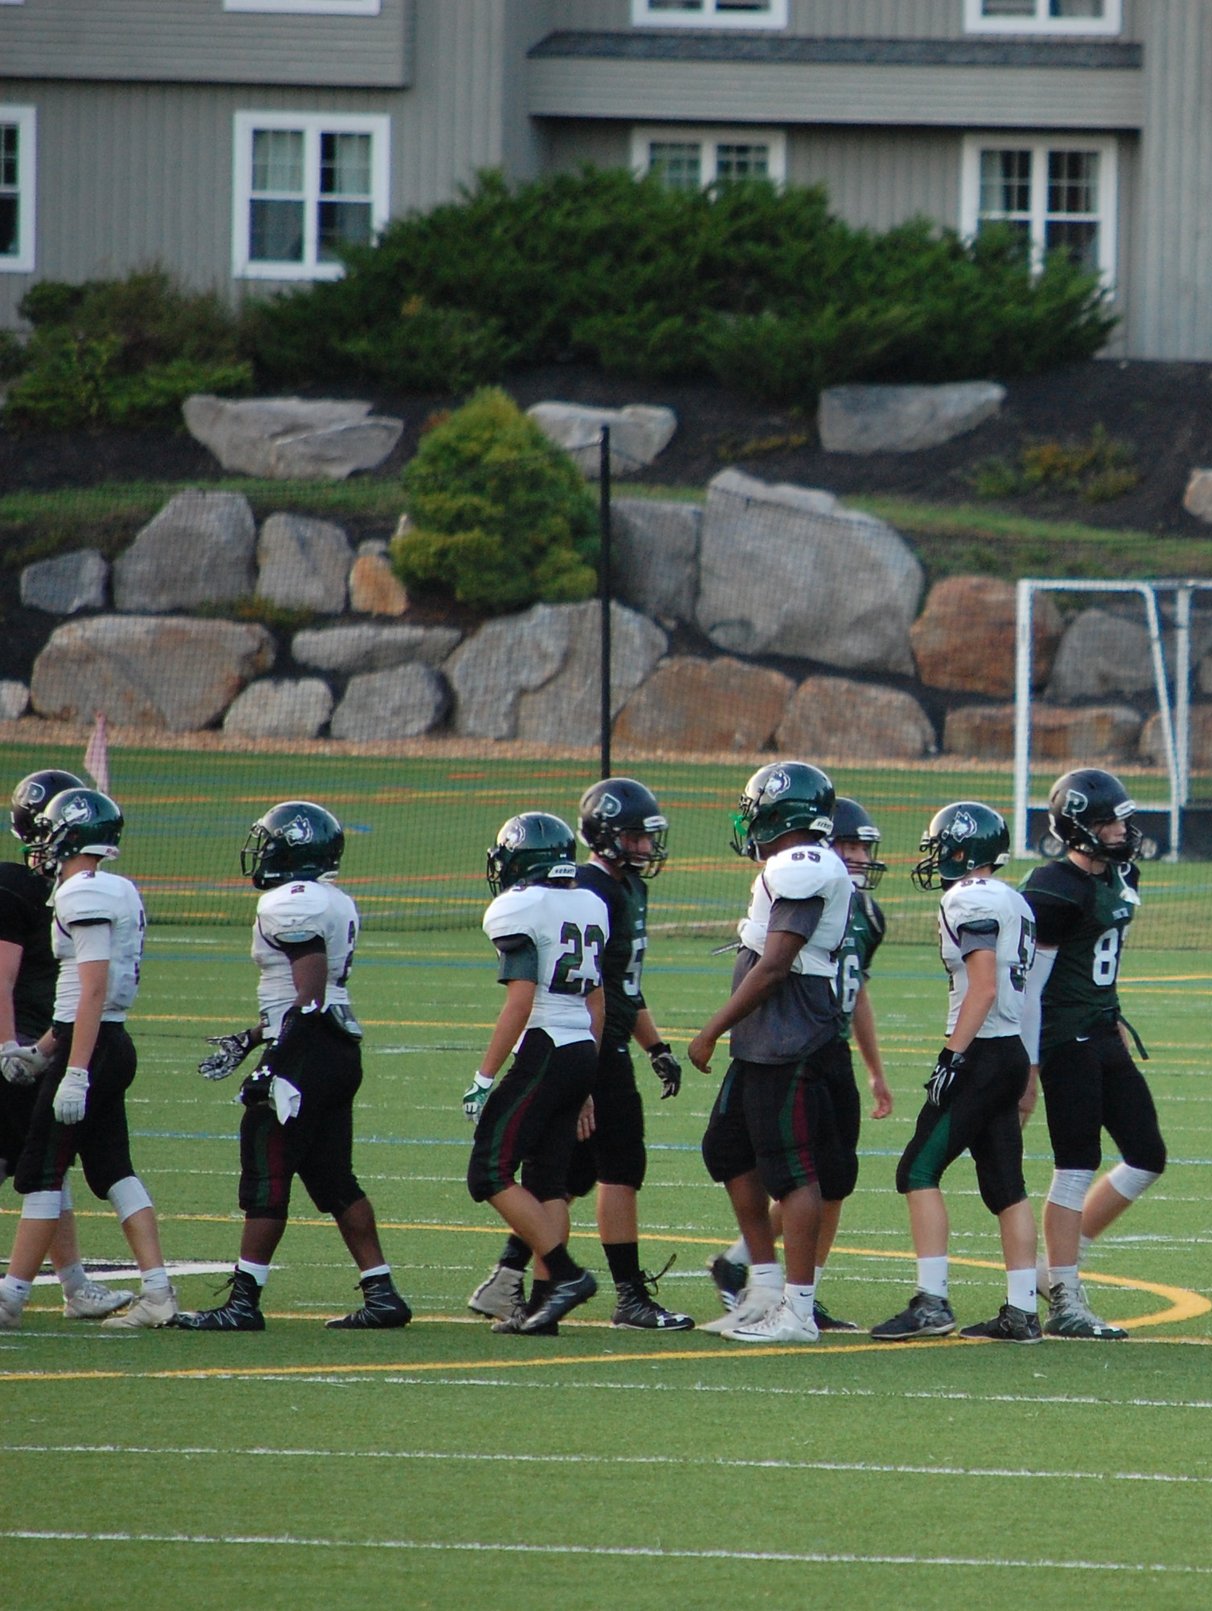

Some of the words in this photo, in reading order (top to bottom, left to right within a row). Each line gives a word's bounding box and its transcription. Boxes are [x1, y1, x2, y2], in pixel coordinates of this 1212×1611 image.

[1062, 789, 1088, 818] P
[549, 921, 607, 995] 23
[623, 936, 648, 997] 5
[1092, 926, 1128, 986] 8
